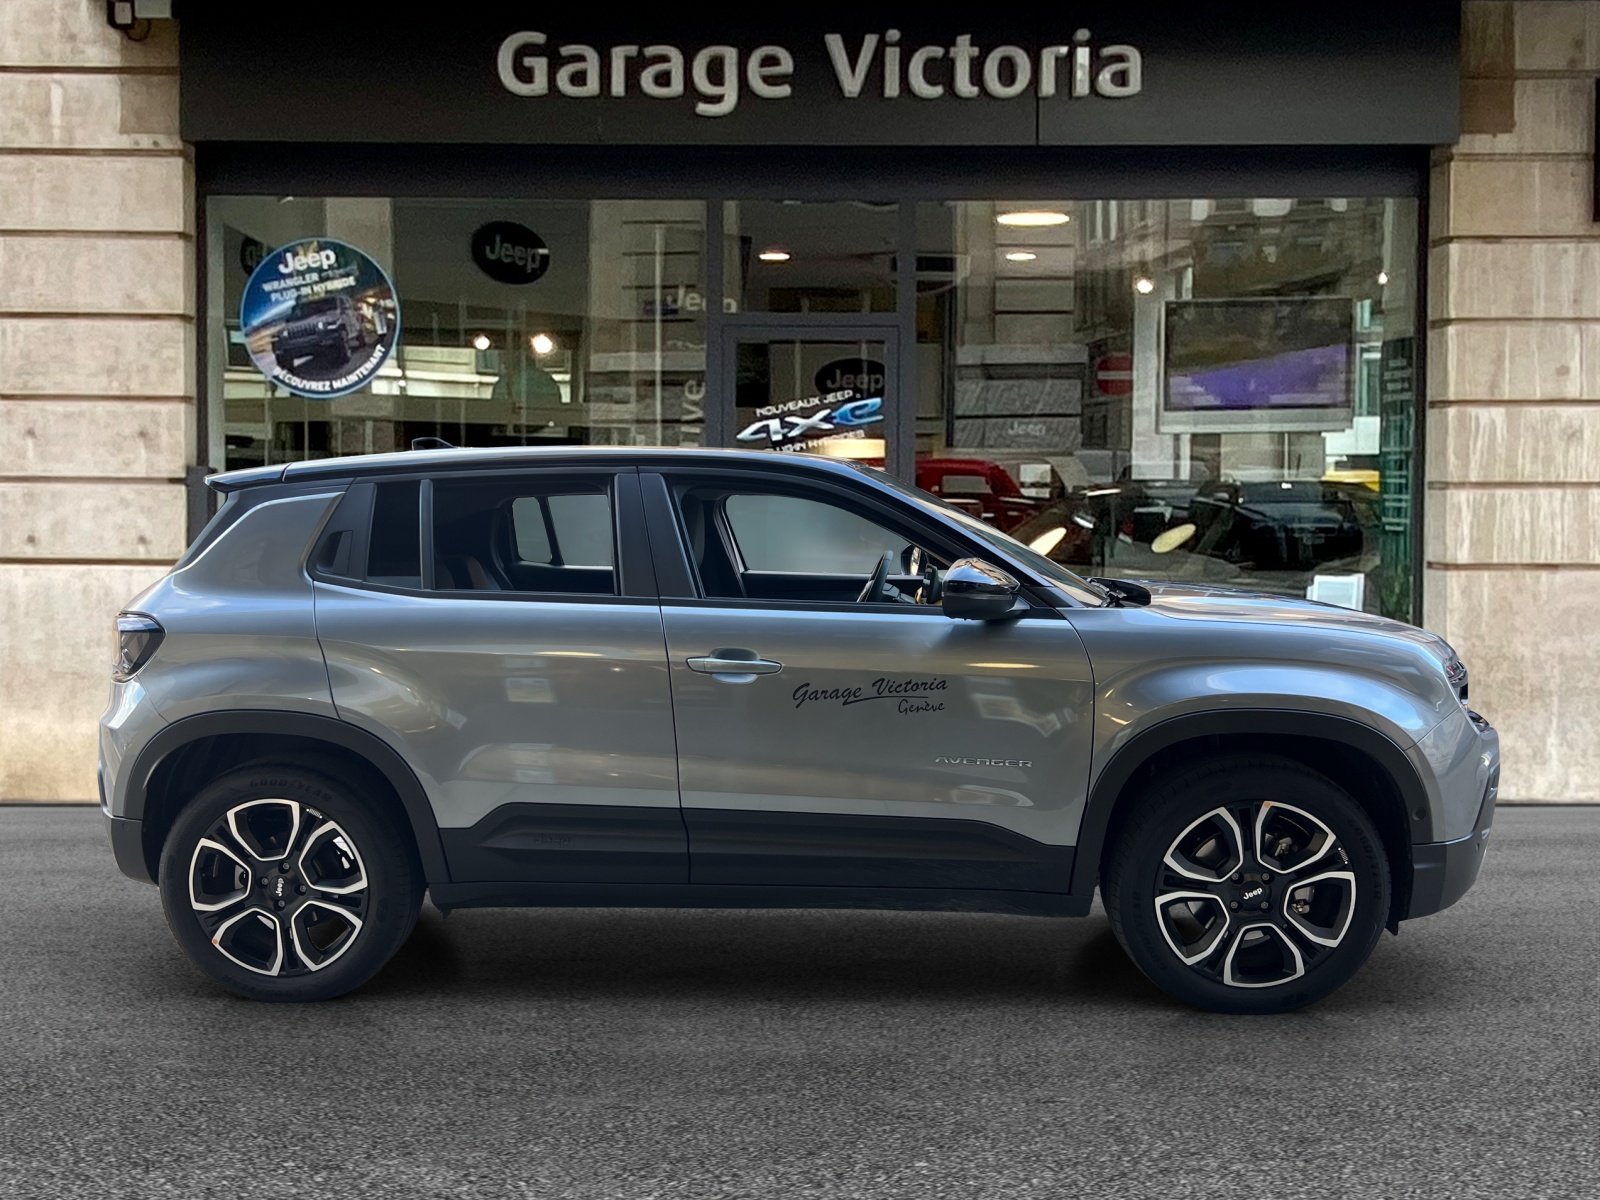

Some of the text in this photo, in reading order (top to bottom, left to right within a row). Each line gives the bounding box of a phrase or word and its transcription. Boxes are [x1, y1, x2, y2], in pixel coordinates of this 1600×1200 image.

[496, 28, 1142, 117] Garage Victoria
[278, 249, 336, 274] Jeep
[485, 234, 541, 272] Jeep
[262, 273, 319, 292] WRANGLER
[270, 276, 356, 302] PLUG-IN HYBRIDE
[332, 344, 386, 389] MAINTENANT
[827, 369, 883, 392] Jeep
[756, 396, 821, 417] NOUVEAUX
[792, 678, 948, 708] Garage Victoria
[898, 699, 945, 715] Genève
[935, 756, 1032, 768] AVENGER
[275, 877, 285, 897] Jeep
[1243, 887, 1263, 900] Jeep
